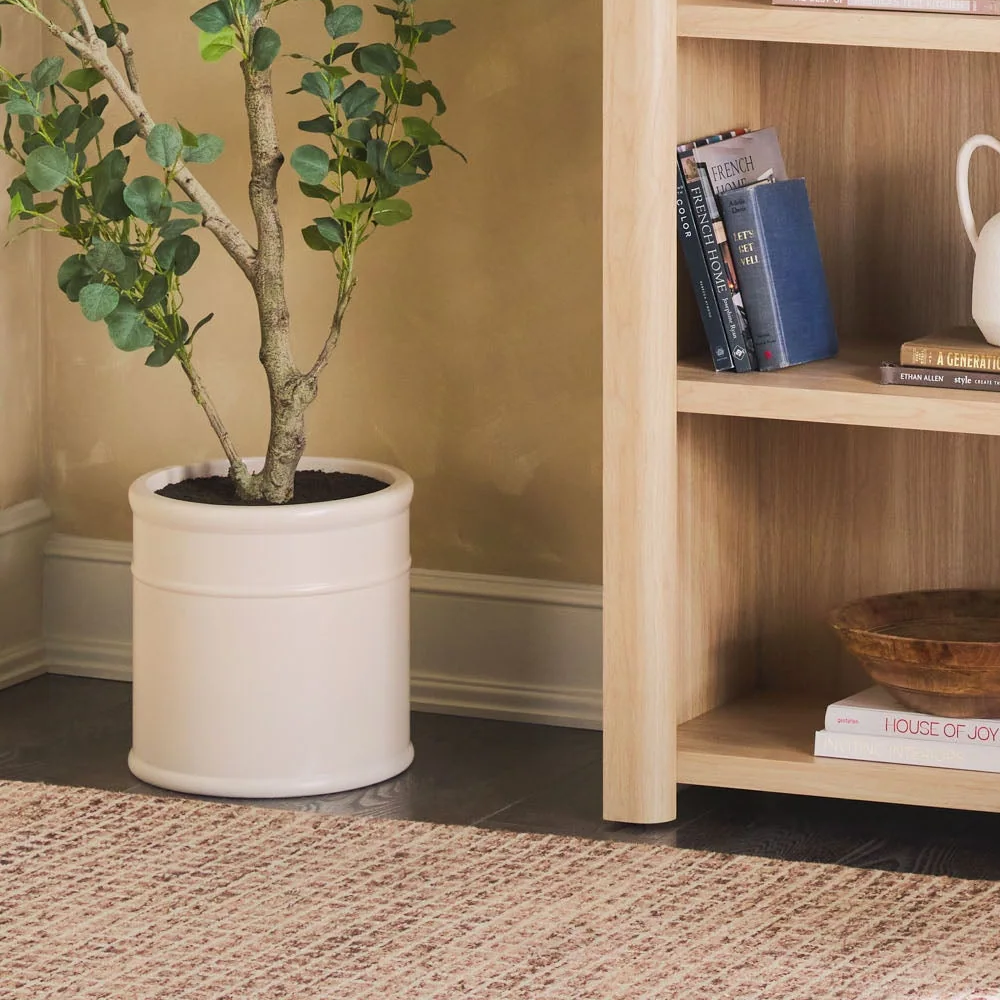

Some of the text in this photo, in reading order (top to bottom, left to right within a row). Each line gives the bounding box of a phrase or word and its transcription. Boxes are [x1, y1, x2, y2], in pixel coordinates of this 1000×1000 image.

[711, 155, 755, 182] FRENCH
[676, 199, 692, 238] COLOR
[691, 186, 715, 246] FRENCH
[707, 249, 728, 294] HOME
[937, 351, 944, 366] A
[900, 372, 922, 380] ETHAN
[923, 374, 944, 382] ALLEN
[954, 375, 972, 386] style
[885, 717, 940, 736] HOUSE
[943, 723, 966, 738] OF
[967, 726, 1000, 741] JOY
